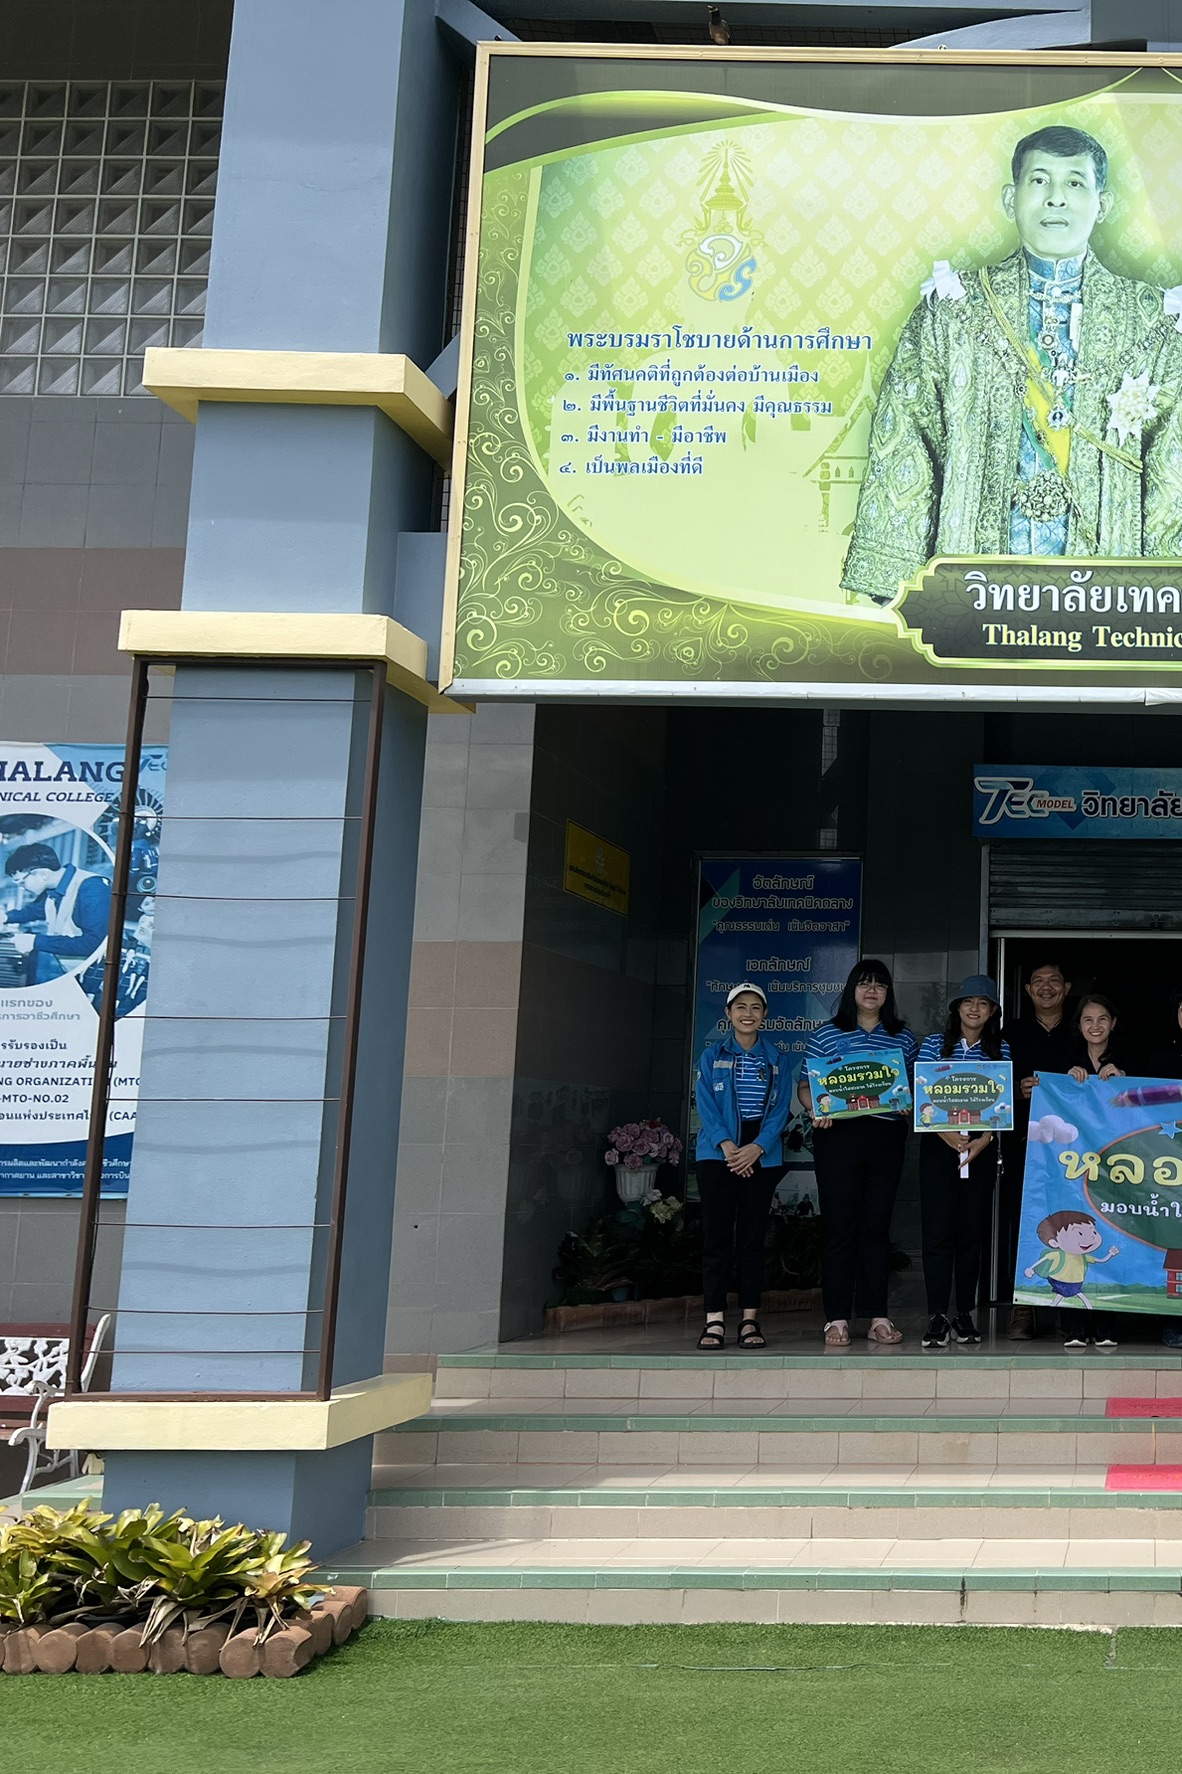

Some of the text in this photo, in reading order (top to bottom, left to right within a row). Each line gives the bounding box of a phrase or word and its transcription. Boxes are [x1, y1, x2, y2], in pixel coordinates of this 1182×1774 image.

[567, 326, 872, 351] พระบรมราโชบายด้านการศึกษา
[587, 358, 819, 387] มีทัศนคติที่ถูกต้องต่อบ้านเมือง
[563, 389, 832, 418] ๒. มีพื้นฐานชีวิตที่มั่นคง มีคุณธรรม
[587, 426, 649, 444] มีงานทำ
[672, 425, 727, 444] มีอาชีพ
[586, 451, 703, 475] เป็นพลเมืองที่ดี
[982, 623, 1082, 652] Thalang
[46, 792, 115, 803] COLLEGE
[1036, 799, 1074, 810] MODEL
[0, 1011, 80, 1021] การอาชีวศึกษา
[16, 1077, 93, 1086] ORGANIZATI
[817, 1065, 900, 1086] หลอมรวมใจ
[923, 1080, 1005, 1095] หลอมรวมใจ
